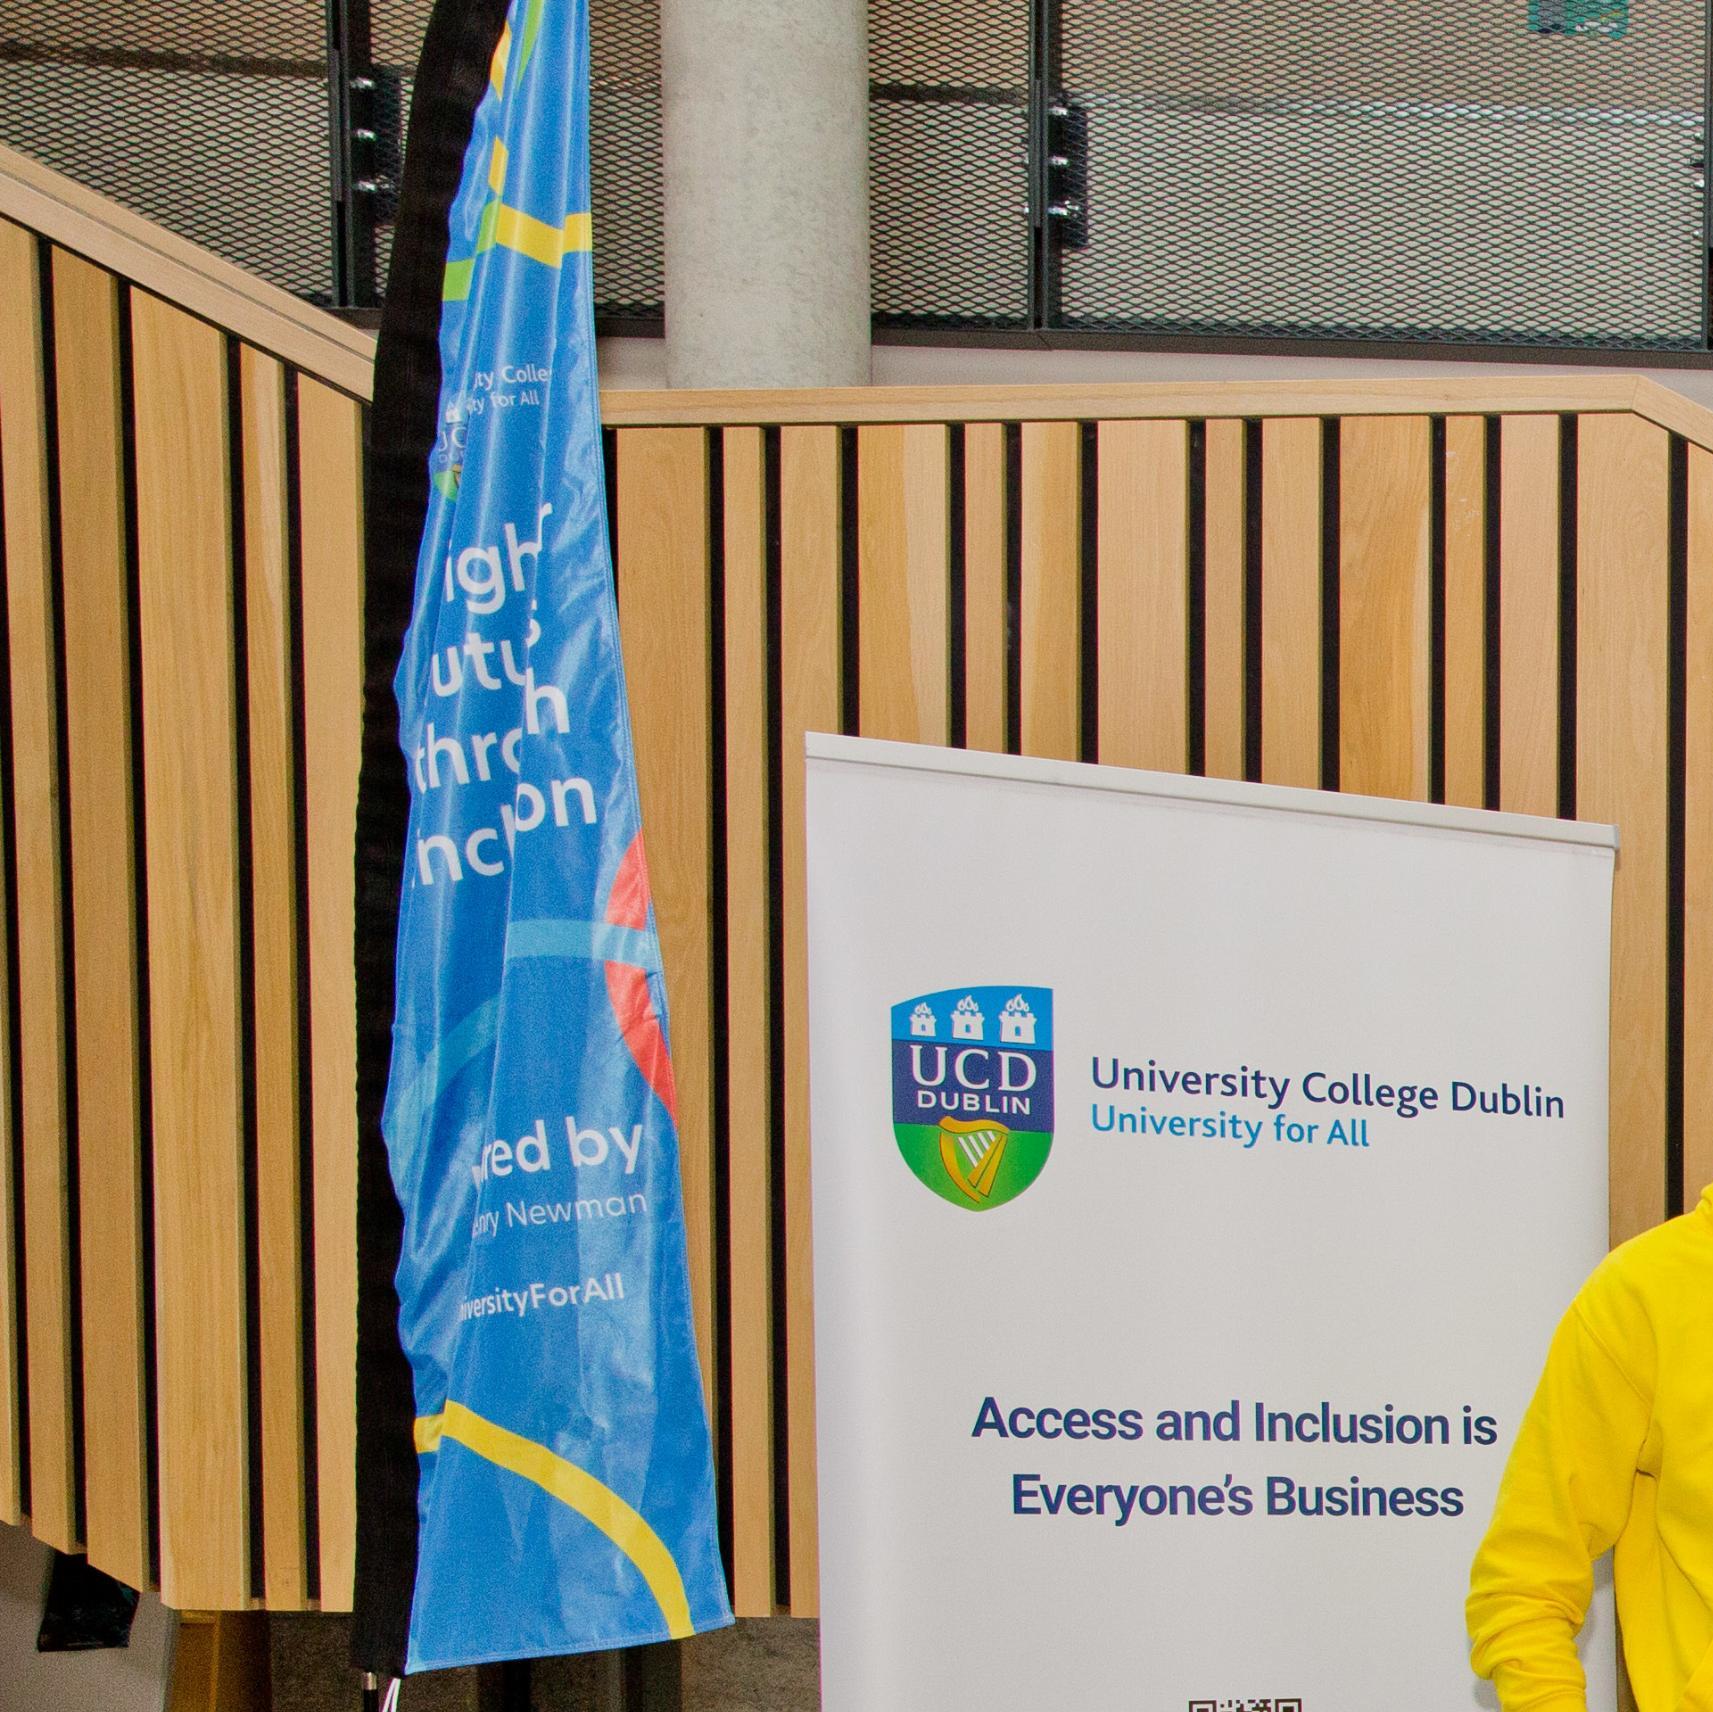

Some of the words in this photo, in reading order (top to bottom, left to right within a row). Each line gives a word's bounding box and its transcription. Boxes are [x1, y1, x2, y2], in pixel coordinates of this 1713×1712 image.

[520, 389, 540, 405] All
[911, 1044, 1037, 1093] UCD
[1091, 1057, 1291, 1109] University
[1302, 1072, 1439, 1111] College
[1451, 1082, 1565, 1119] Dublin
[917, 1090, 1031, 1115] DUBLIN
[1091, 1104, 1263, 1148] University
[1273, 1114, 1319, 1145] for
[1327, 1119, 1370, 1147] All
[565, 1116, 642, 1175] by
[505, 1192, 648, 1228] Newman
[972, 1397, 1143, 1441] Access
[1156, 1400, 1240, 1442] and
[1255, 1403, 1449, 1445] Inclusion
[1463, 1405, 1498, 1445] is
[1012, 1473, 1253, 1527] Everyone's
[1266, 1476, 1465, 1517] Business
